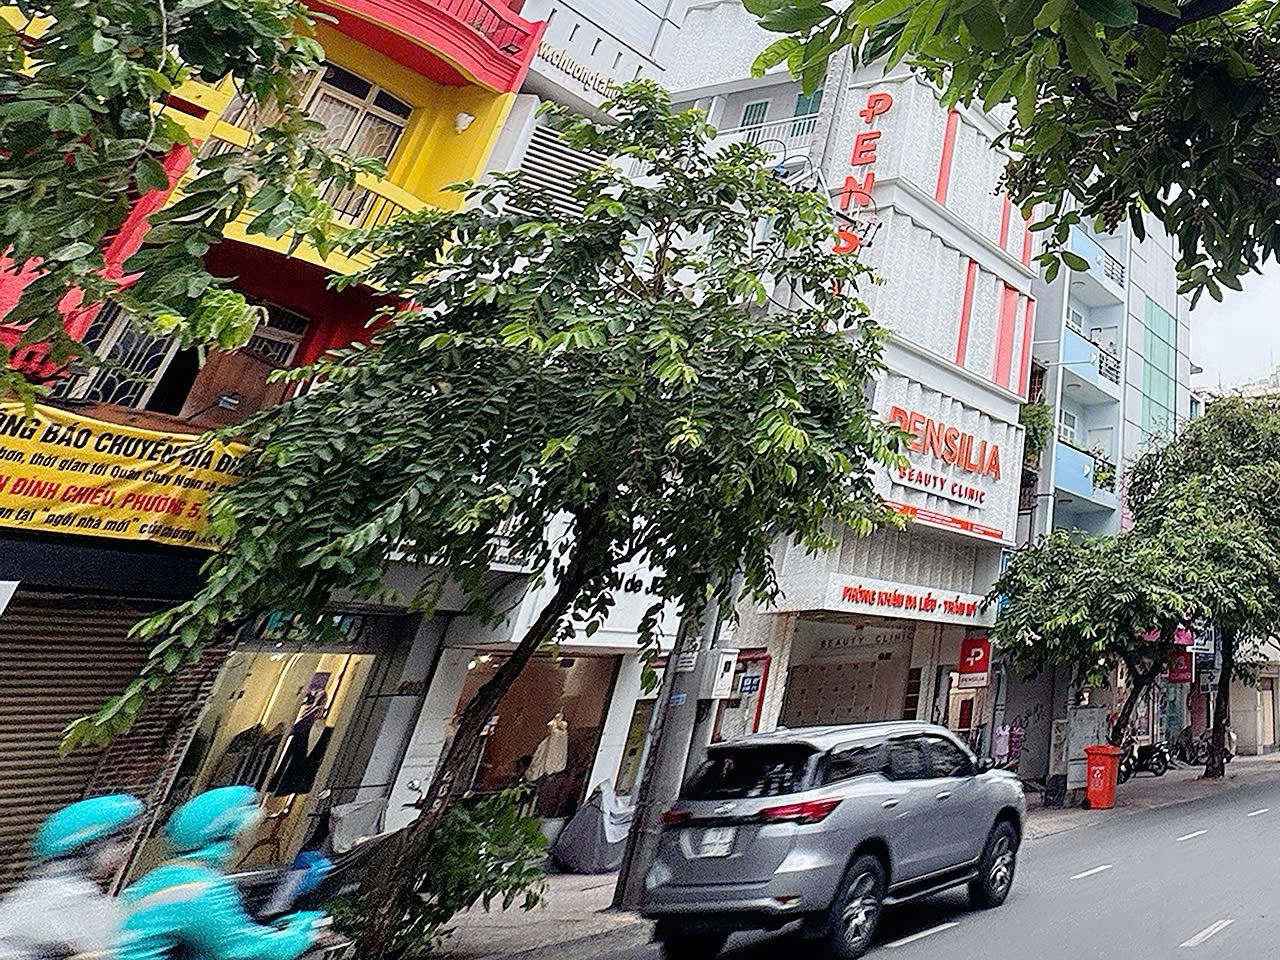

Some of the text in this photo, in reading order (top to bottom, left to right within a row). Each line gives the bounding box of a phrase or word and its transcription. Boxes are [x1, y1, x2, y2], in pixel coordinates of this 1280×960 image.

[40, 421, 92, 449] BÁO
[889, 405, 1001, 481] PENSILIA
[58, 458, 89, 473] gian
[898, 465, 986, 504] BEAUTY CLINIC
